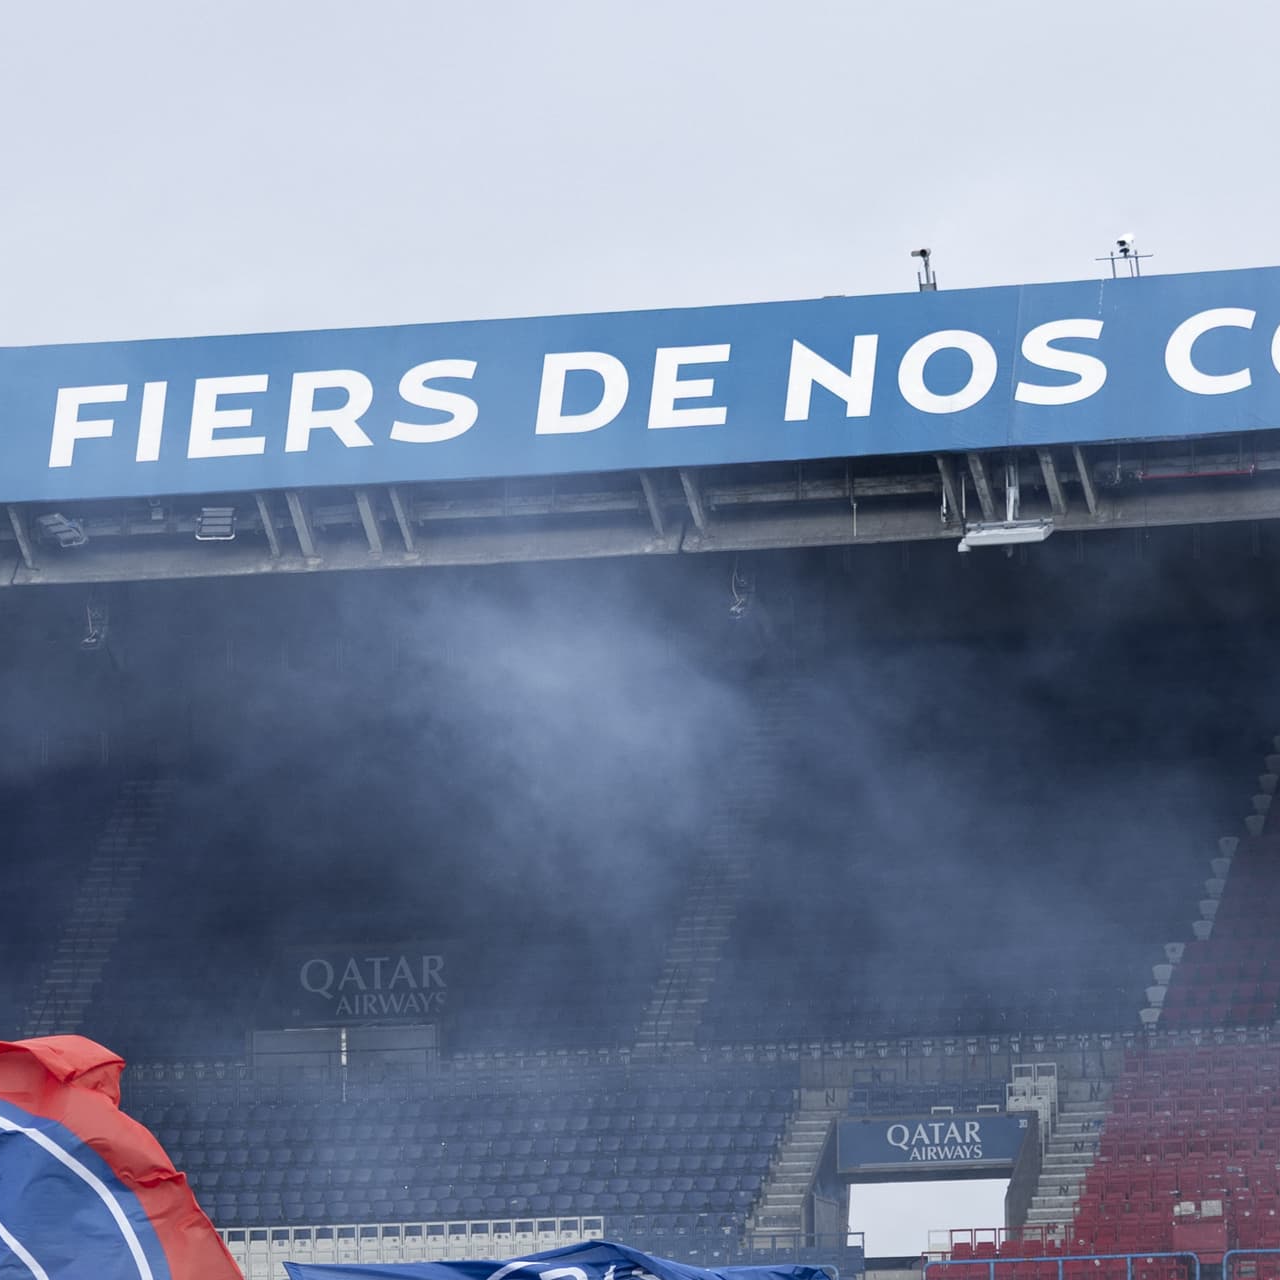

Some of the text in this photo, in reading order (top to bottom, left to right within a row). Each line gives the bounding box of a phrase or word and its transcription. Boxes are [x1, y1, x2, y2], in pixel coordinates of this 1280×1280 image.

[49, 359, 478, 468] FIERS
[535, 344, 731, 436] DE
[784, 317, 1108, 422] NOS
[300, 954, 447, 996] QATAR
[335, 991, 447, 1017] AIRWAYS
[886, 1121, 982, 1151] QATAR
[909, 1144, 983, 1161] AIRWAYS
